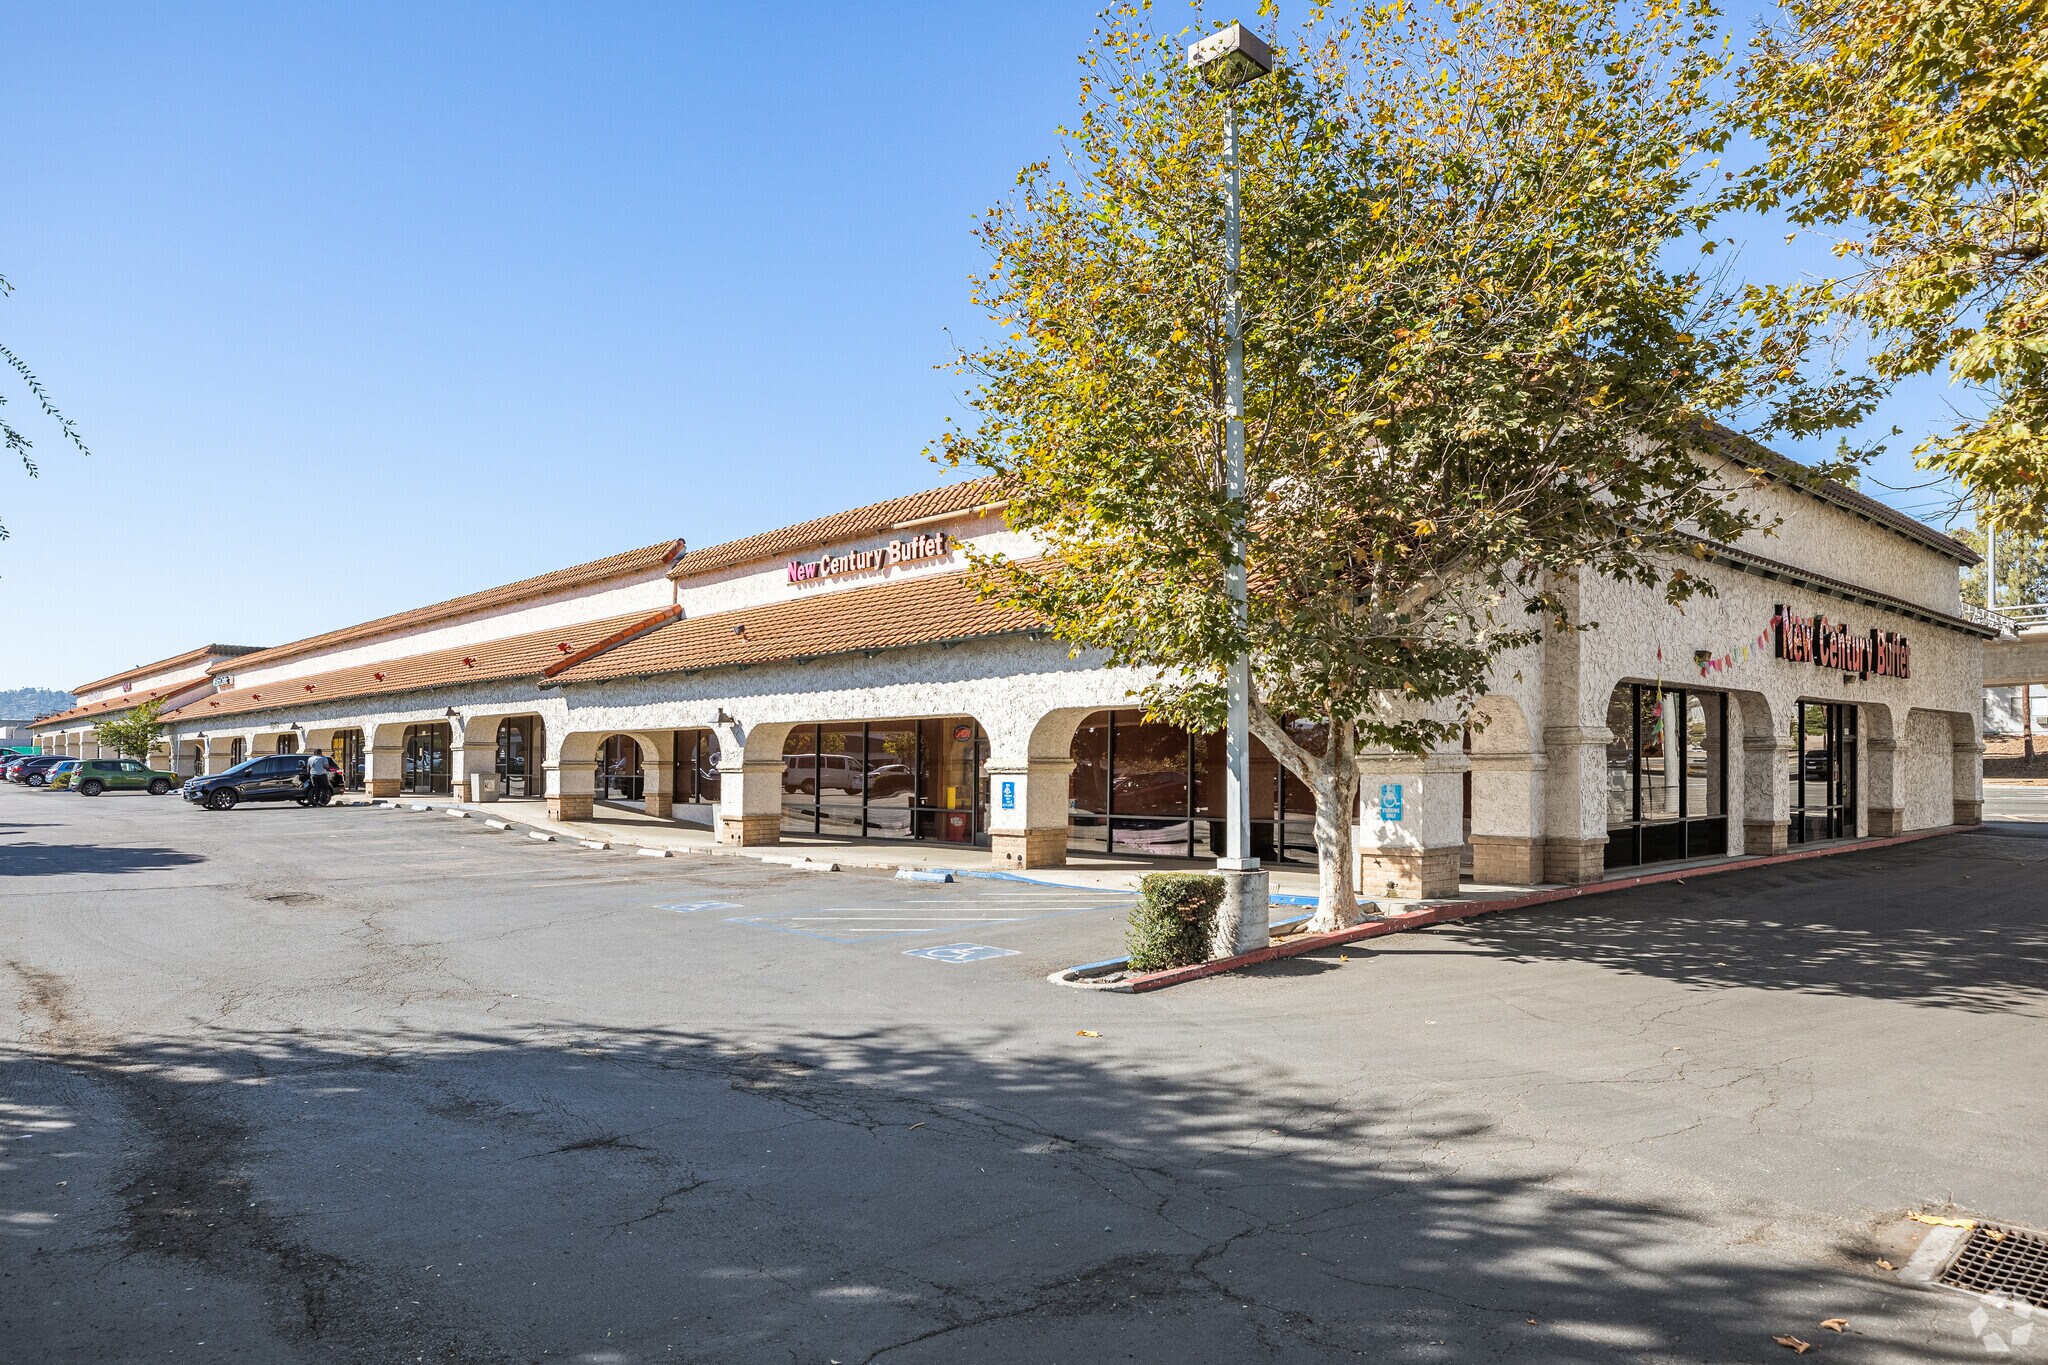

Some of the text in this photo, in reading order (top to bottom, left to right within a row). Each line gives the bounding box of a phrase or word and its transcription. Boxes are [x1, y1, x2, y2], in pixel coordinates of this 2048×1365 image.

[787, 532, 944, 582] New Century Buffet
[1781, 604, 1911, 681] New Century Buffet
